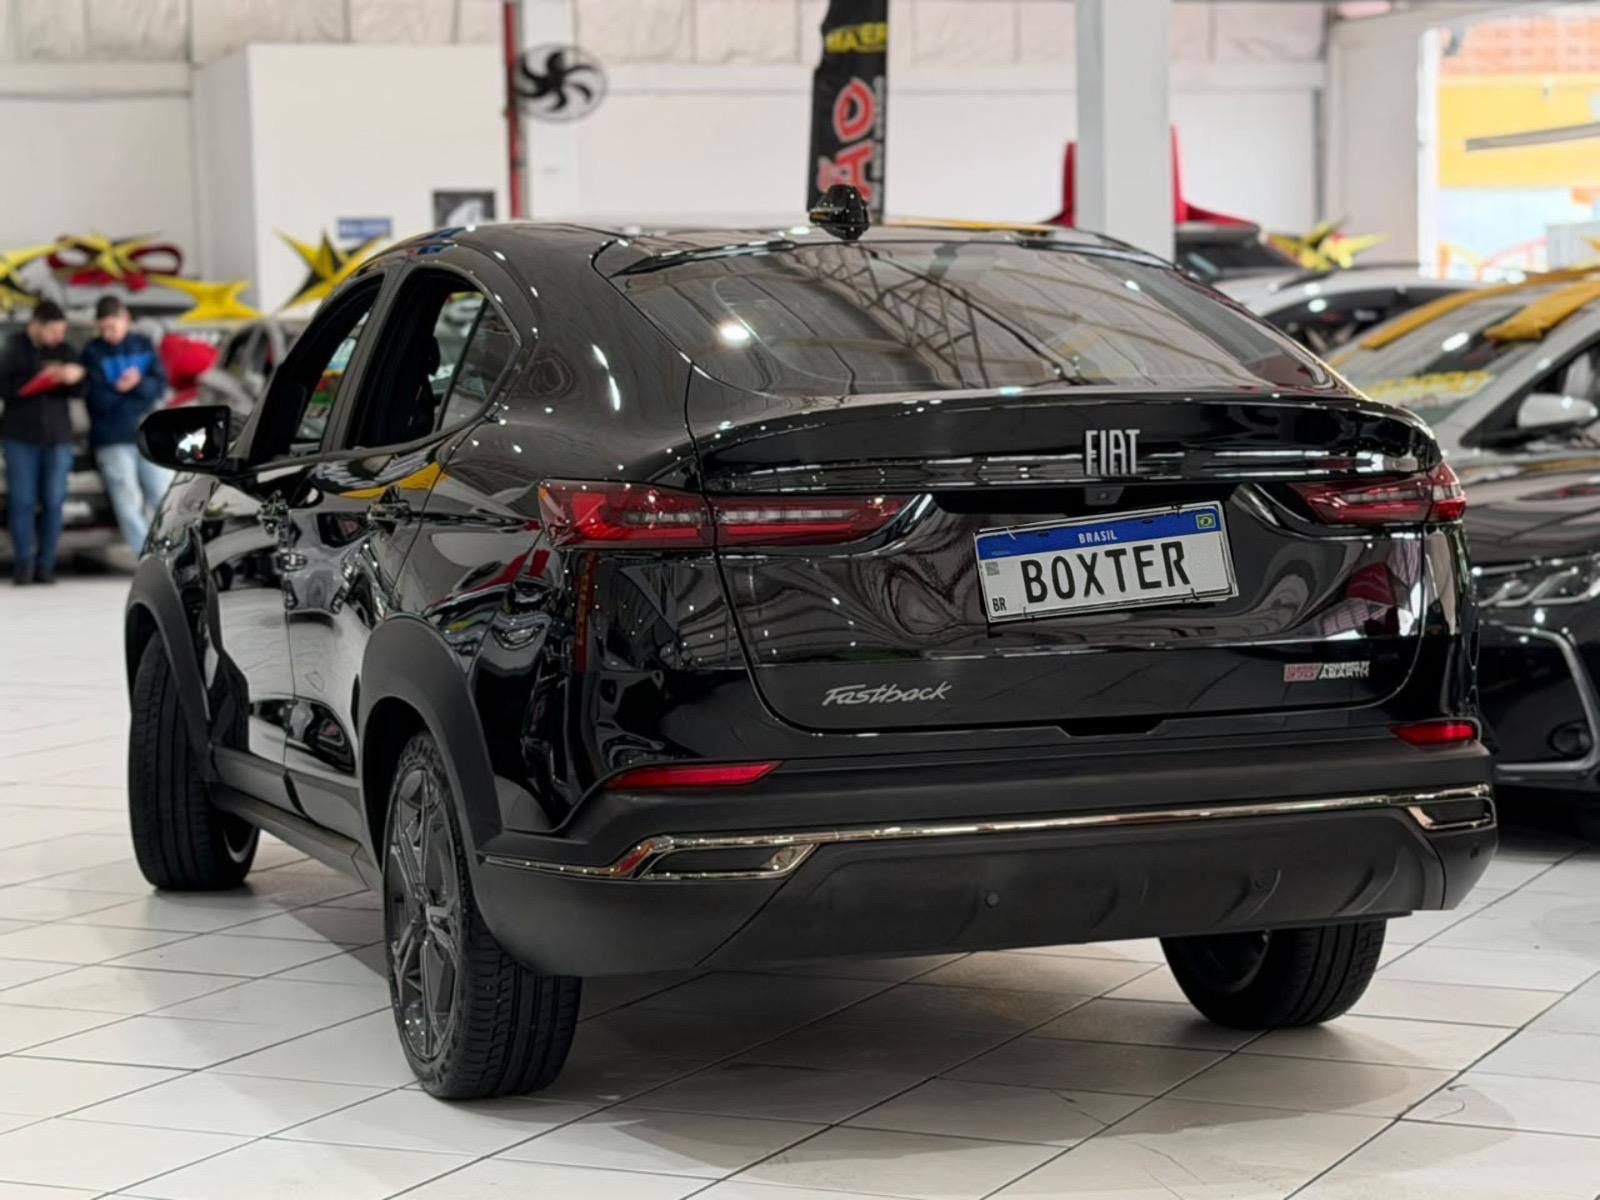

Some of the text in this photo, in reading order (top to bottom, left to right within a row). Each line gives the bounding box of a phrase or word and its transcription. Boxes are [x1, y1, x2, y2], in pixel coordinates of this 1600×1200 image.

[1085, 429, 1140, 475] FIAT
[1079, 529, 1118, 544] BRASIL
[1021, 541, 1191, 603] BOXTER
[992, 597, 1007, 612] BR
[821, 680, 952, 706] Fastback
